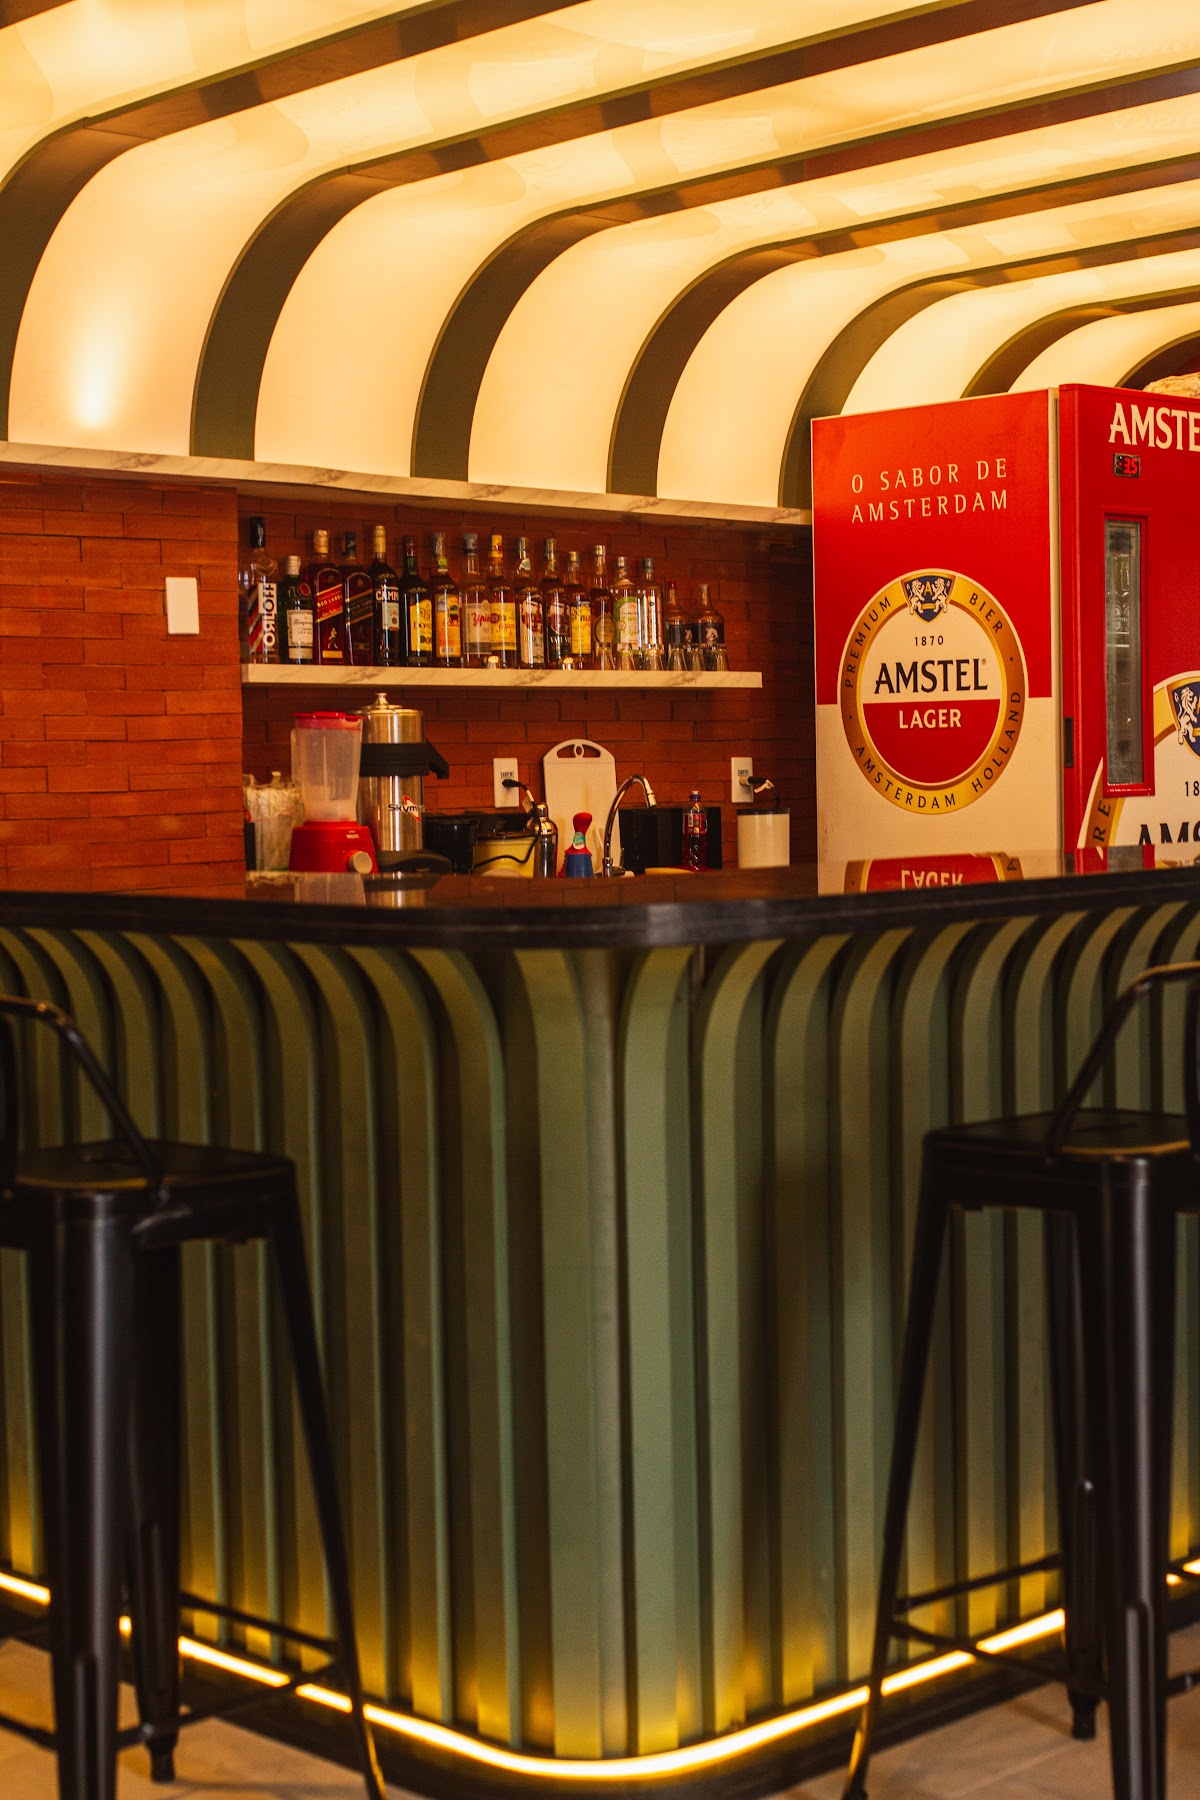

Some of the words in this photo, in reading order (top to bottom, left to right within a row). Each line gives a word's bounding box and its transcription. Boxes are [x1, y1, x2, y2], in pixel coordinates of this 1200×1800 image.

[1108, 402, 1200, 453] AMSTE
[851, 474, 863, 494] O
[880, 463, 959, 491] SABOR
[976, 457, 1007, 480] DE
[851, 489, 1007, 524] AMSTERDAM
[969, 592, 1003, 633] BIER
[845, 595, 891, 688] PREMIUM
[914, 635, 944, 647] 1870
[874, 658, 988, 694] AMSTEL
[899, 708, 962, 729] LAGER
[971, 691, 1021, 793] HOLLAND
[855, 745, 956, 809] AMSTERDAM
